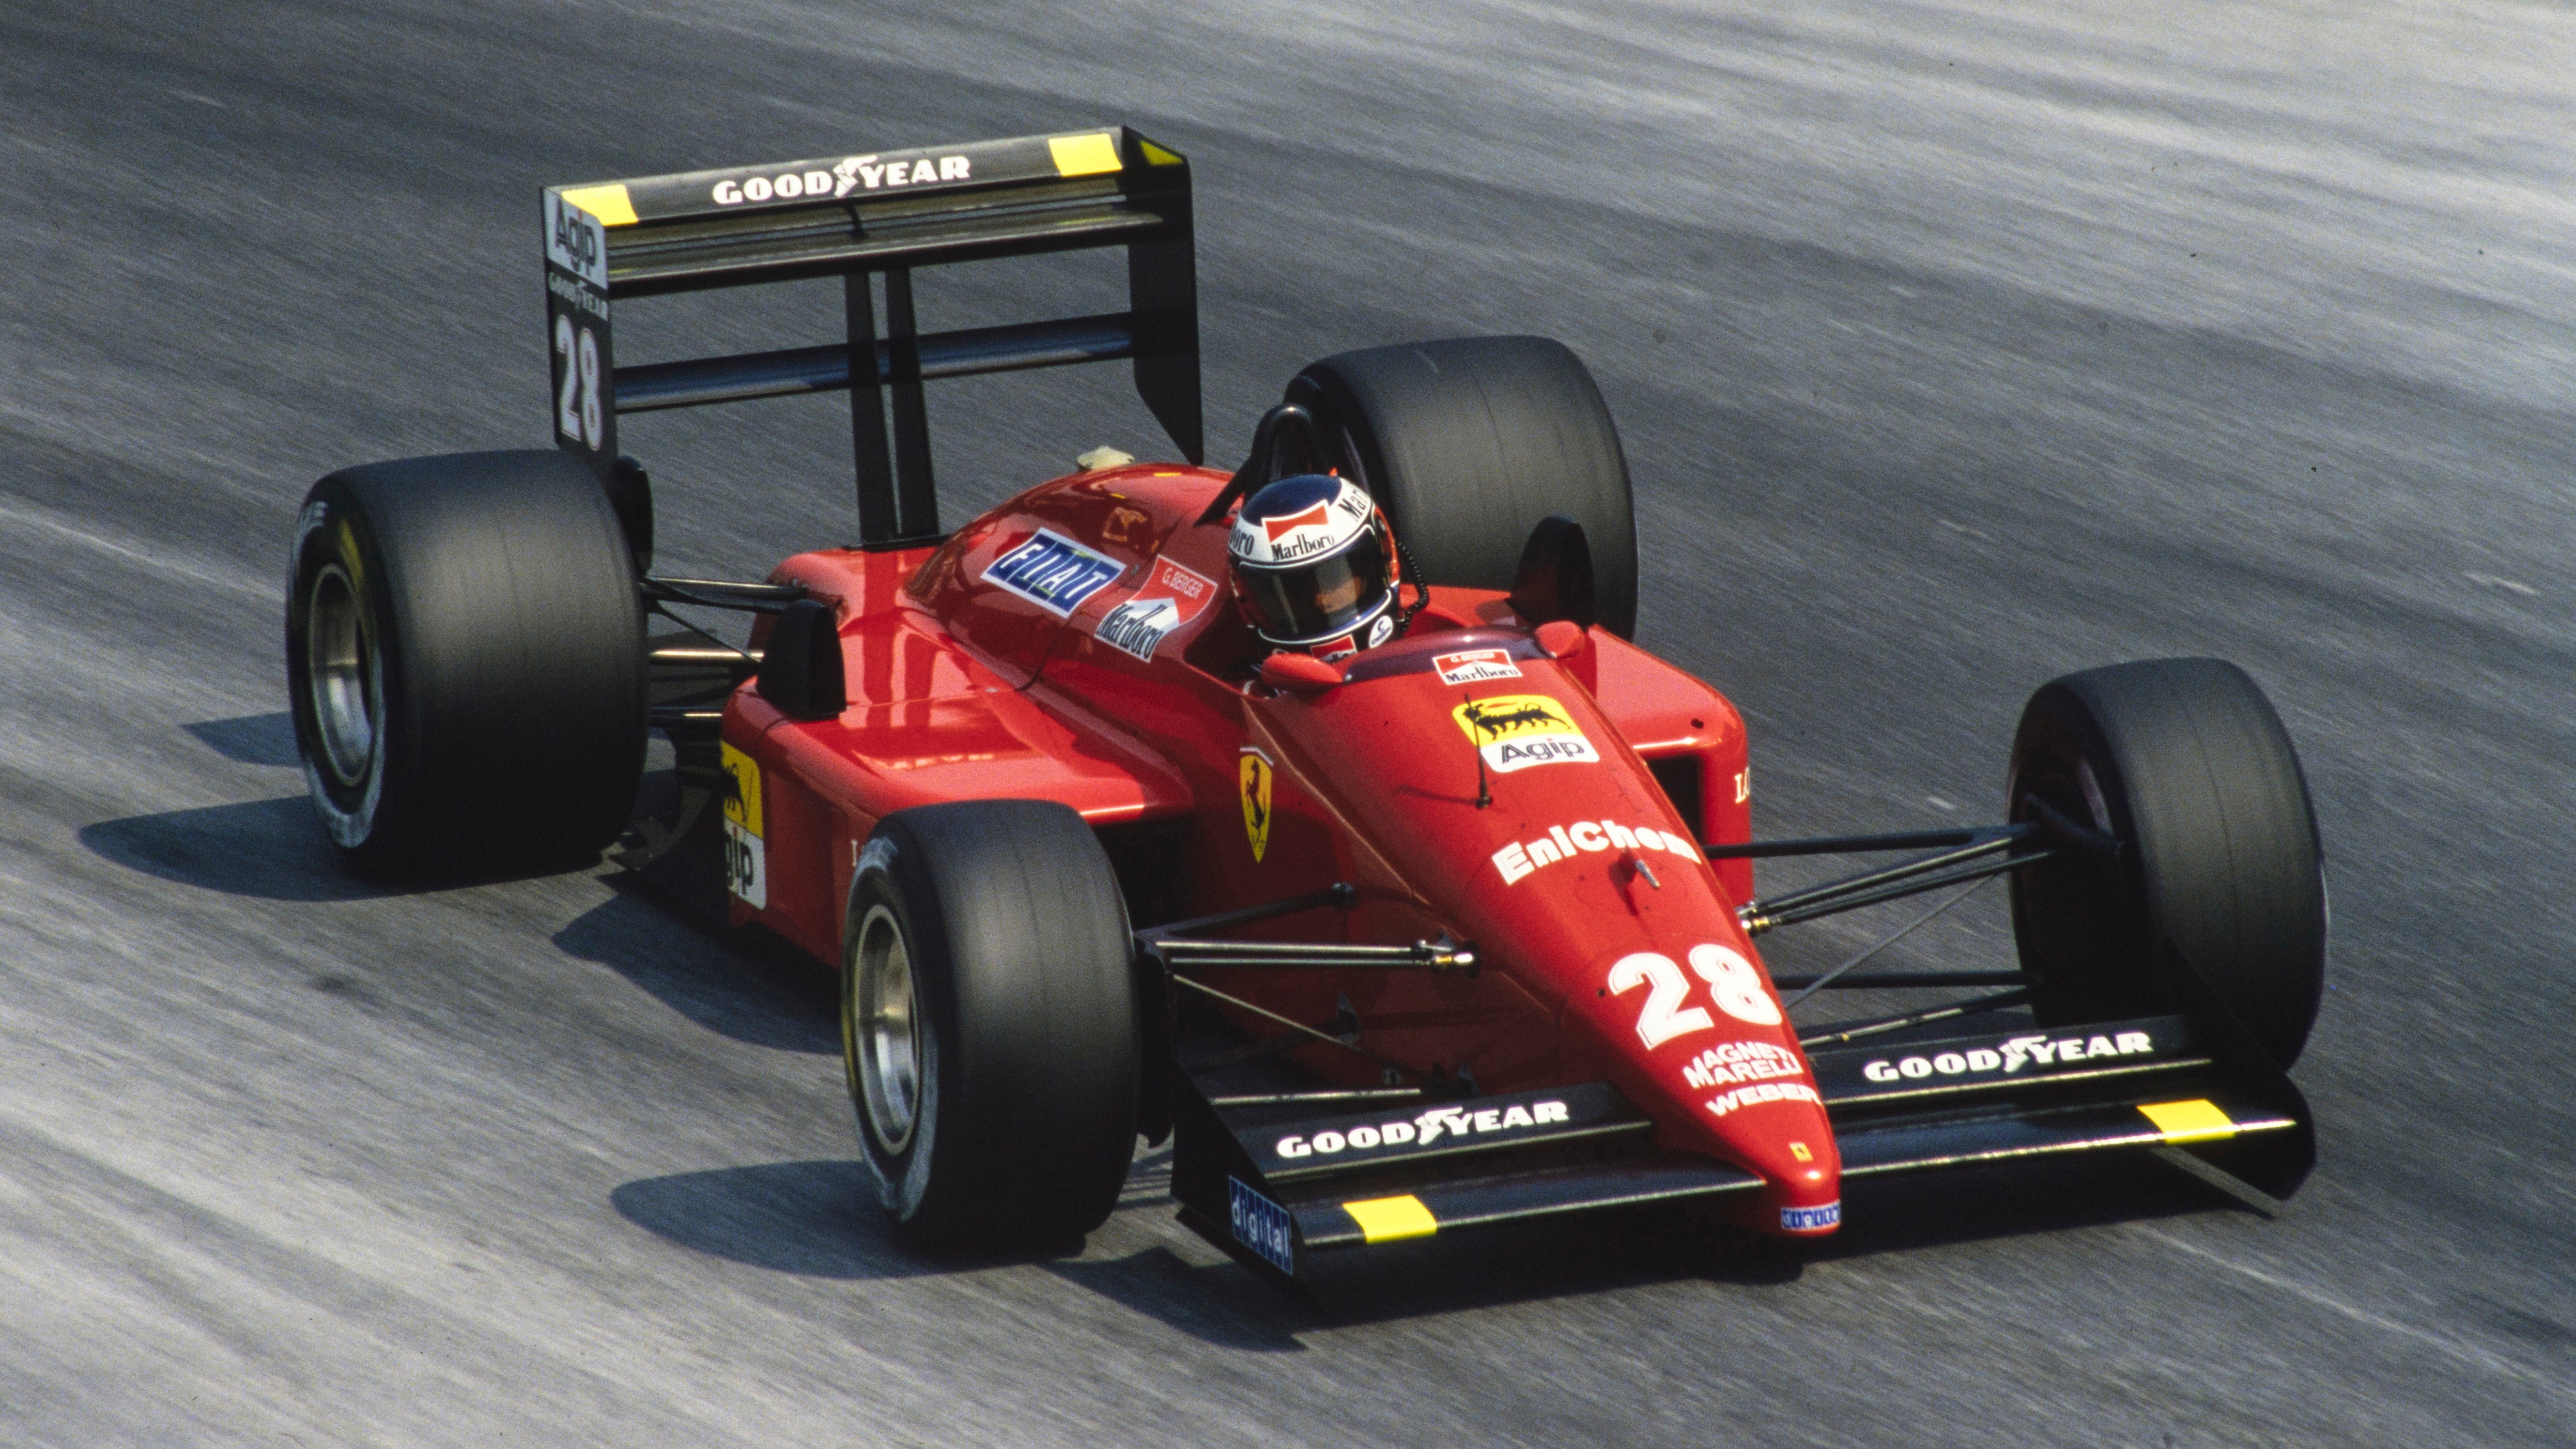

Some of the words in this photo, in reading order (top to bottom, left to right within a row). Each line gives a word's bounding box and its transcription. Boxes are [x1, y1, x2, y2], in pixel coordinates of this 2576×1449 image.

[554, 198, 595, 276] Agip
[555, 314, 603, 451] 28
[999, 543, 1108, 599] FIAT
[1270, 533, 1335, 561] Marlboro
[1169, 571, 1204, 600] BERGER
[1096, 603, 1167, 659] Marlboro
[1445, 666, 1518, 684] Marlboro
[1501, 738, 1585, 764] Agip
[1608, 943, 1782, 1051] 28
[1705, 1083, 1823, 1117] WEBER
[1232, 1195, 1289, 1258] digital
